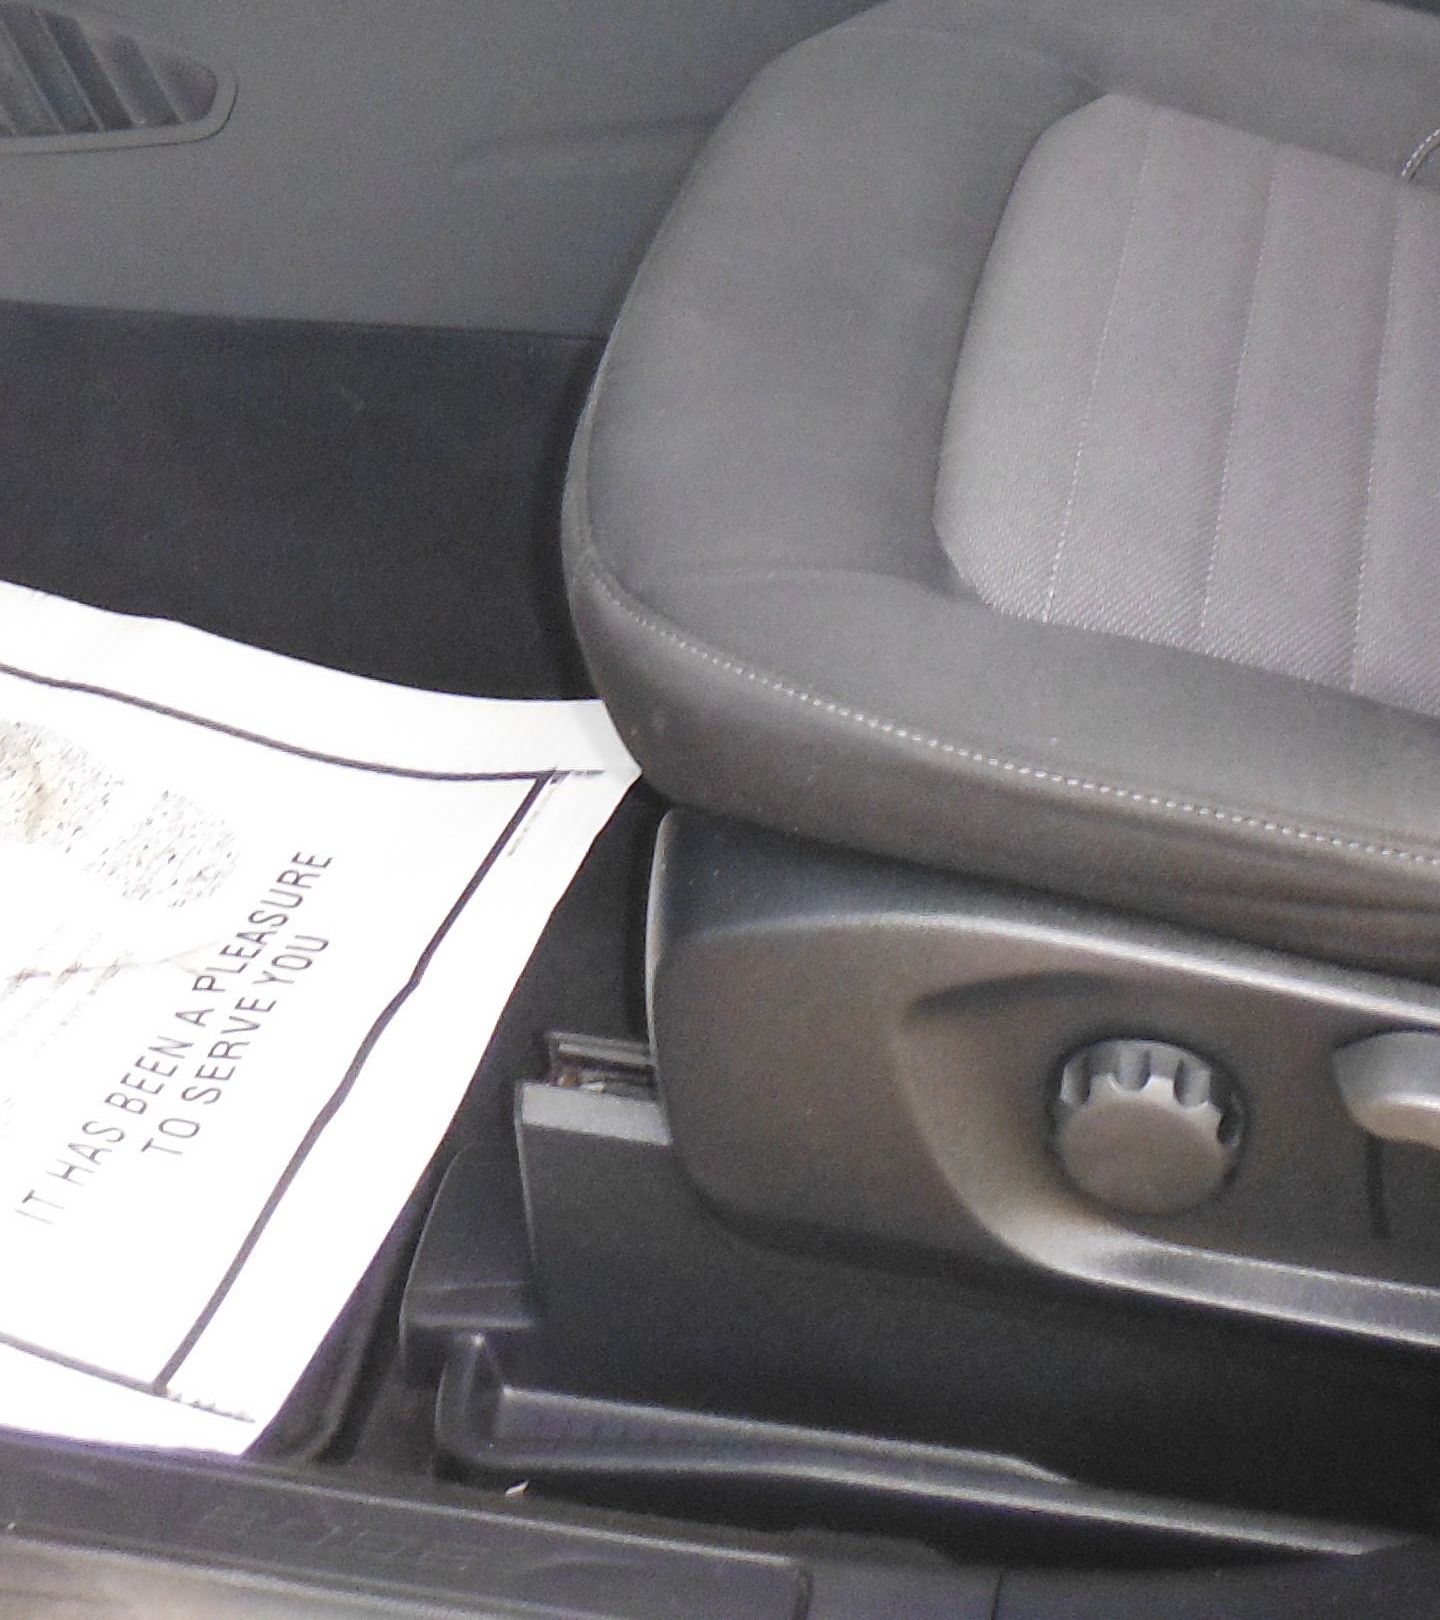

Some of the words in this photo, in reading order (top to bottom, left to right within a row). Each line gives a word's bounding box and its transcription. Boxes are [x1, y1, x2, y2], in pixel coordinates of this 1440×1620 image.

[192, 851, 334, 993] PLEASURE
[141, 1118, 201, 1155] TO
[180, 996, 278, 1105] SERVE
[252, 934, 330, 985] YOU
[174, 1007, 215, 1028] A
[103, 1035, 194, 1115] BEEN
[46, 1120, 126, 1186] HAS
[15, 1189, 65, 1225] IT
